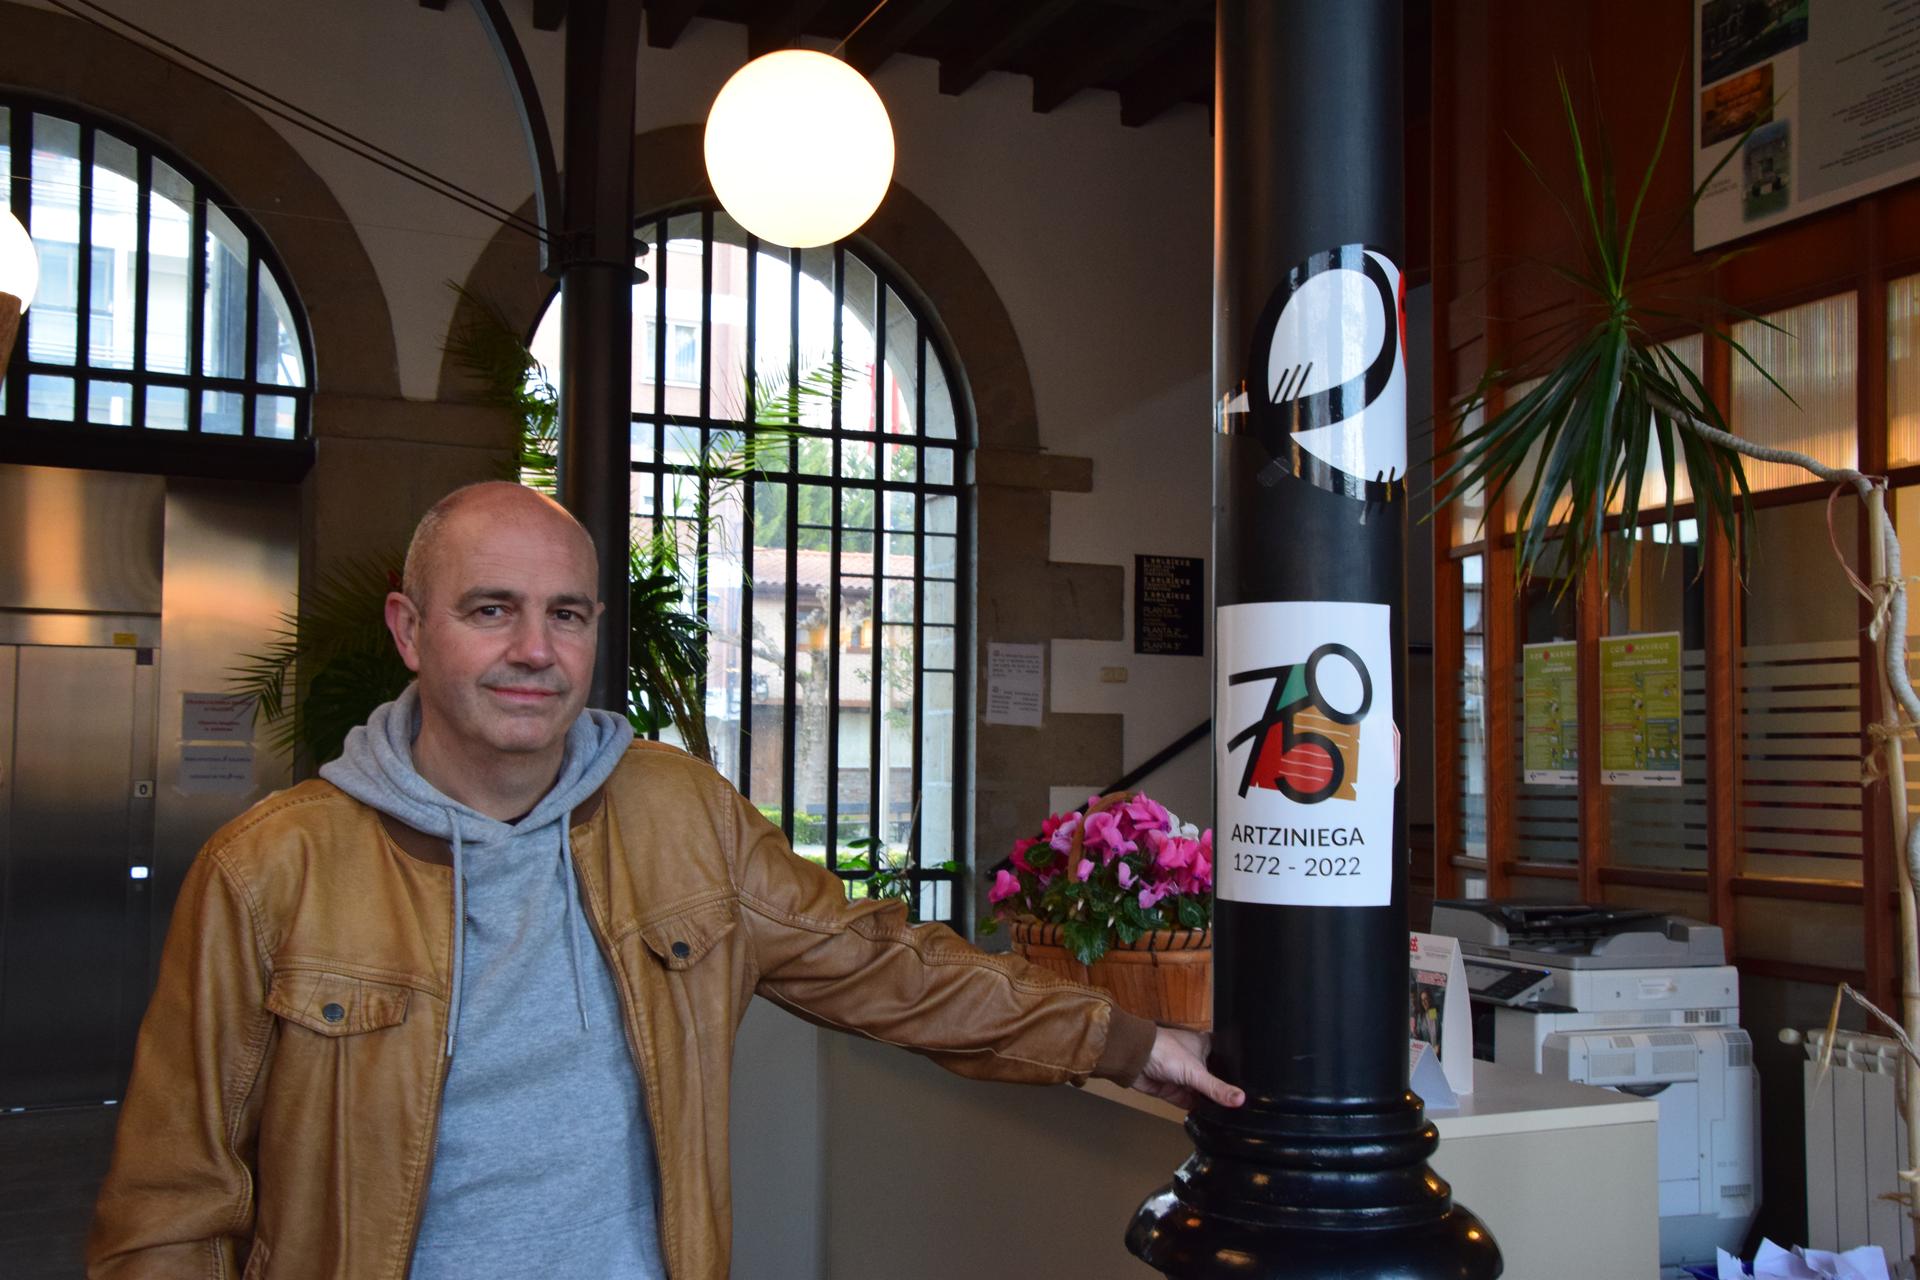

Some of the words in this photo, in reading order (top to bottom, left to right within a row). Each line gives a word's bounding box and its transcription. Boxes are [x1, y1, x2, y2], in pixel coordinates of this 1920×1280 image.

[1231, 824, 1365, 847] ARTZINIEGA
[1233, 852, 1280, 876] 1272
[1304, 856, 1361, 877] 2022
